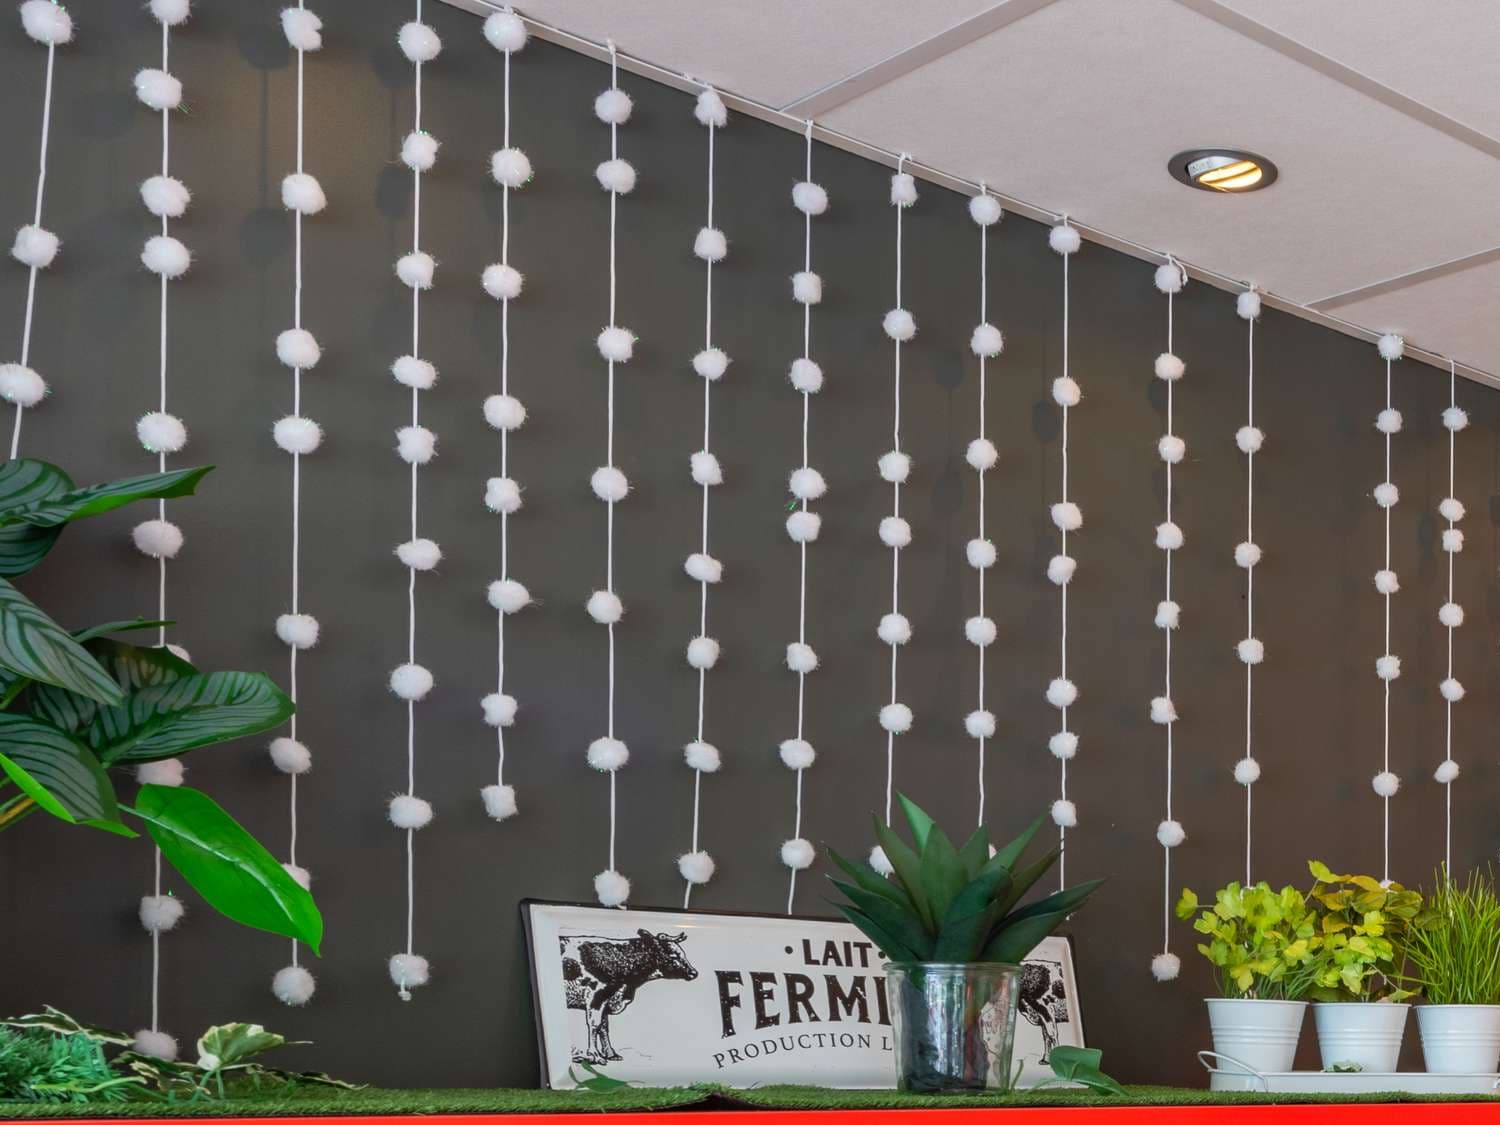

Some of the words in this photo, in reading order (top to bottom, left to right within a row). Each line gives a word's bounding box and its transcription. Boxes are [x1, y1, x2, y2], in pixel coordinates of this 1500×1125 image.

[802, 938, 872, 968] LAIT
[714, 970, 893, 1039] FERMI
[714, 1033, 872, 1069] PRODUCTION
